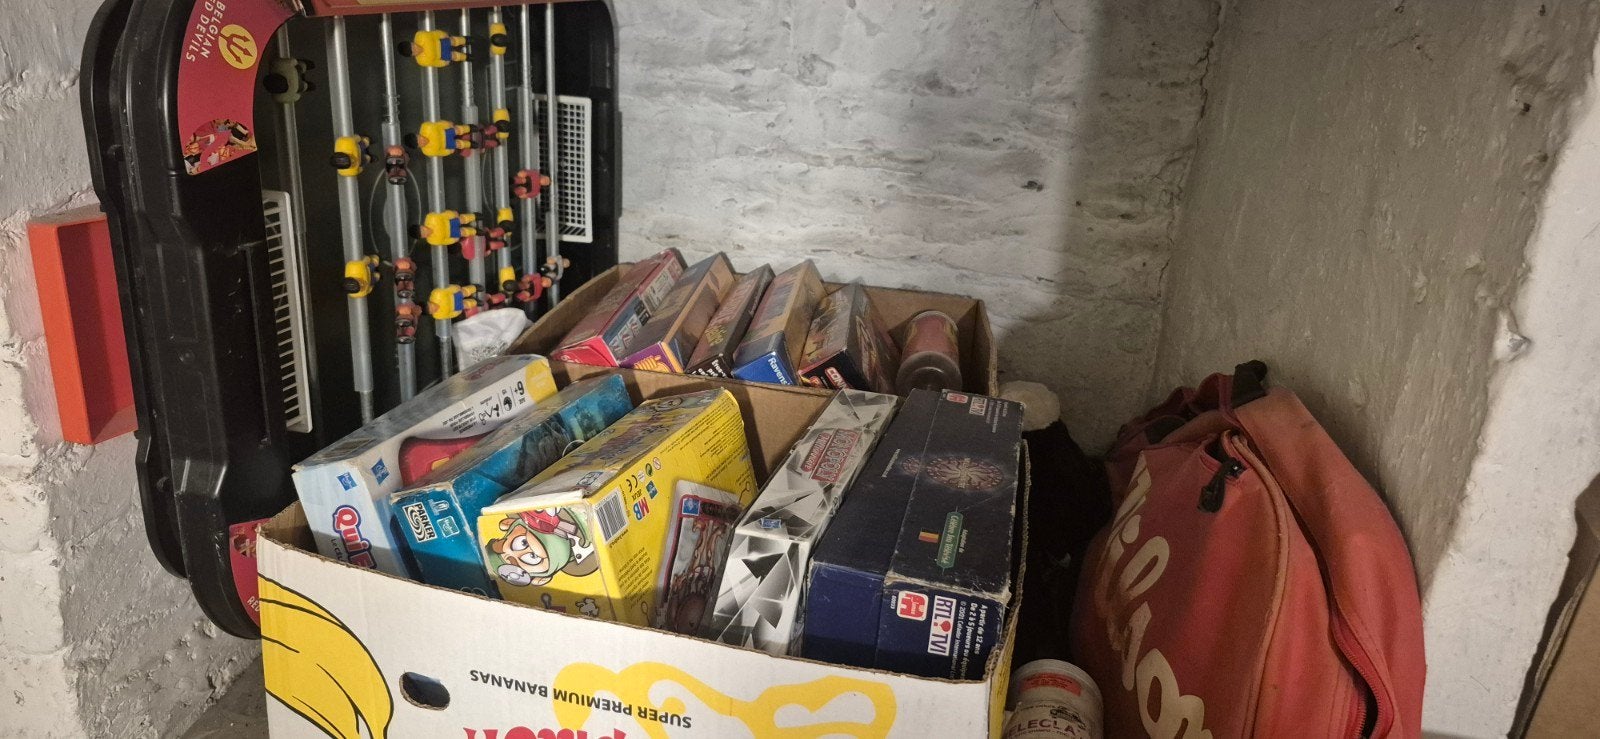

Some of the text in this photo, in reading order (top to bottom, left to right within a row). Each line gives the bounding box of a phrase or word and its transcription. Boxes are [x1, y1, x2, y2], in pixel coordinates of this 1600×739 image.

[186, 14, 210, 62] DEVILS
[200, 0, 226, 58] BELGIAN
[767, 357, 792, 385] Ravens
[414, 503, 435, 539] PARKER
[633, 497, 649, 520] MB
[335, 507, 368, 551] Qui
[970, 602, 978, 612] De
[978, 609, 987, 627] partir
[965, 625, 973, 648] joueurs
[976, 635, 983, 643] 12
[978, 626, 985, 635] de
[469, 669, 692, 729] SUPER PREMIUM BANANAS
